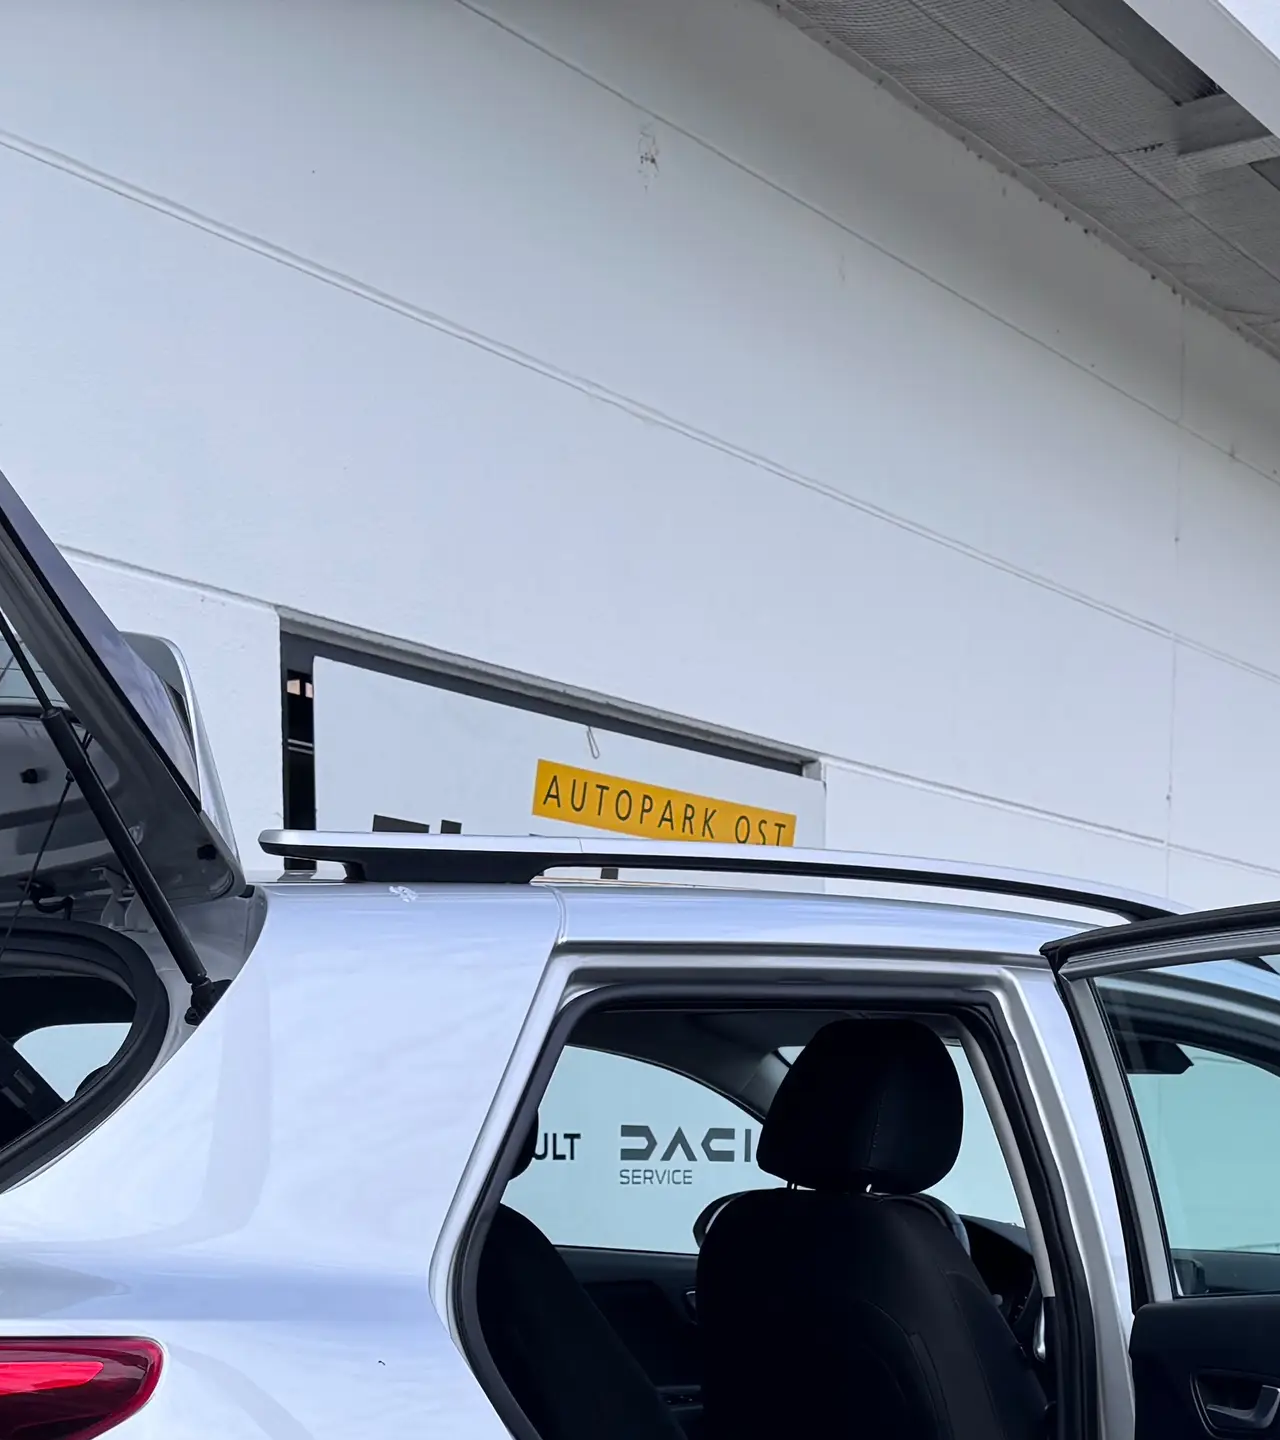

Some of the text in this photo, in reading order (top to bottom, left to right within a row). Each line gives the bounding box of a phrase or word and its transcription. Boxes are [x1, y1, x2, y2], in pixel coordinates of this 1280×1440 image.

[543, 775, 786, 846] AUTOPARK OST
[620, 1124, 752, 1163] DACI
[619, 1168, 693, 1185] SERVICE
